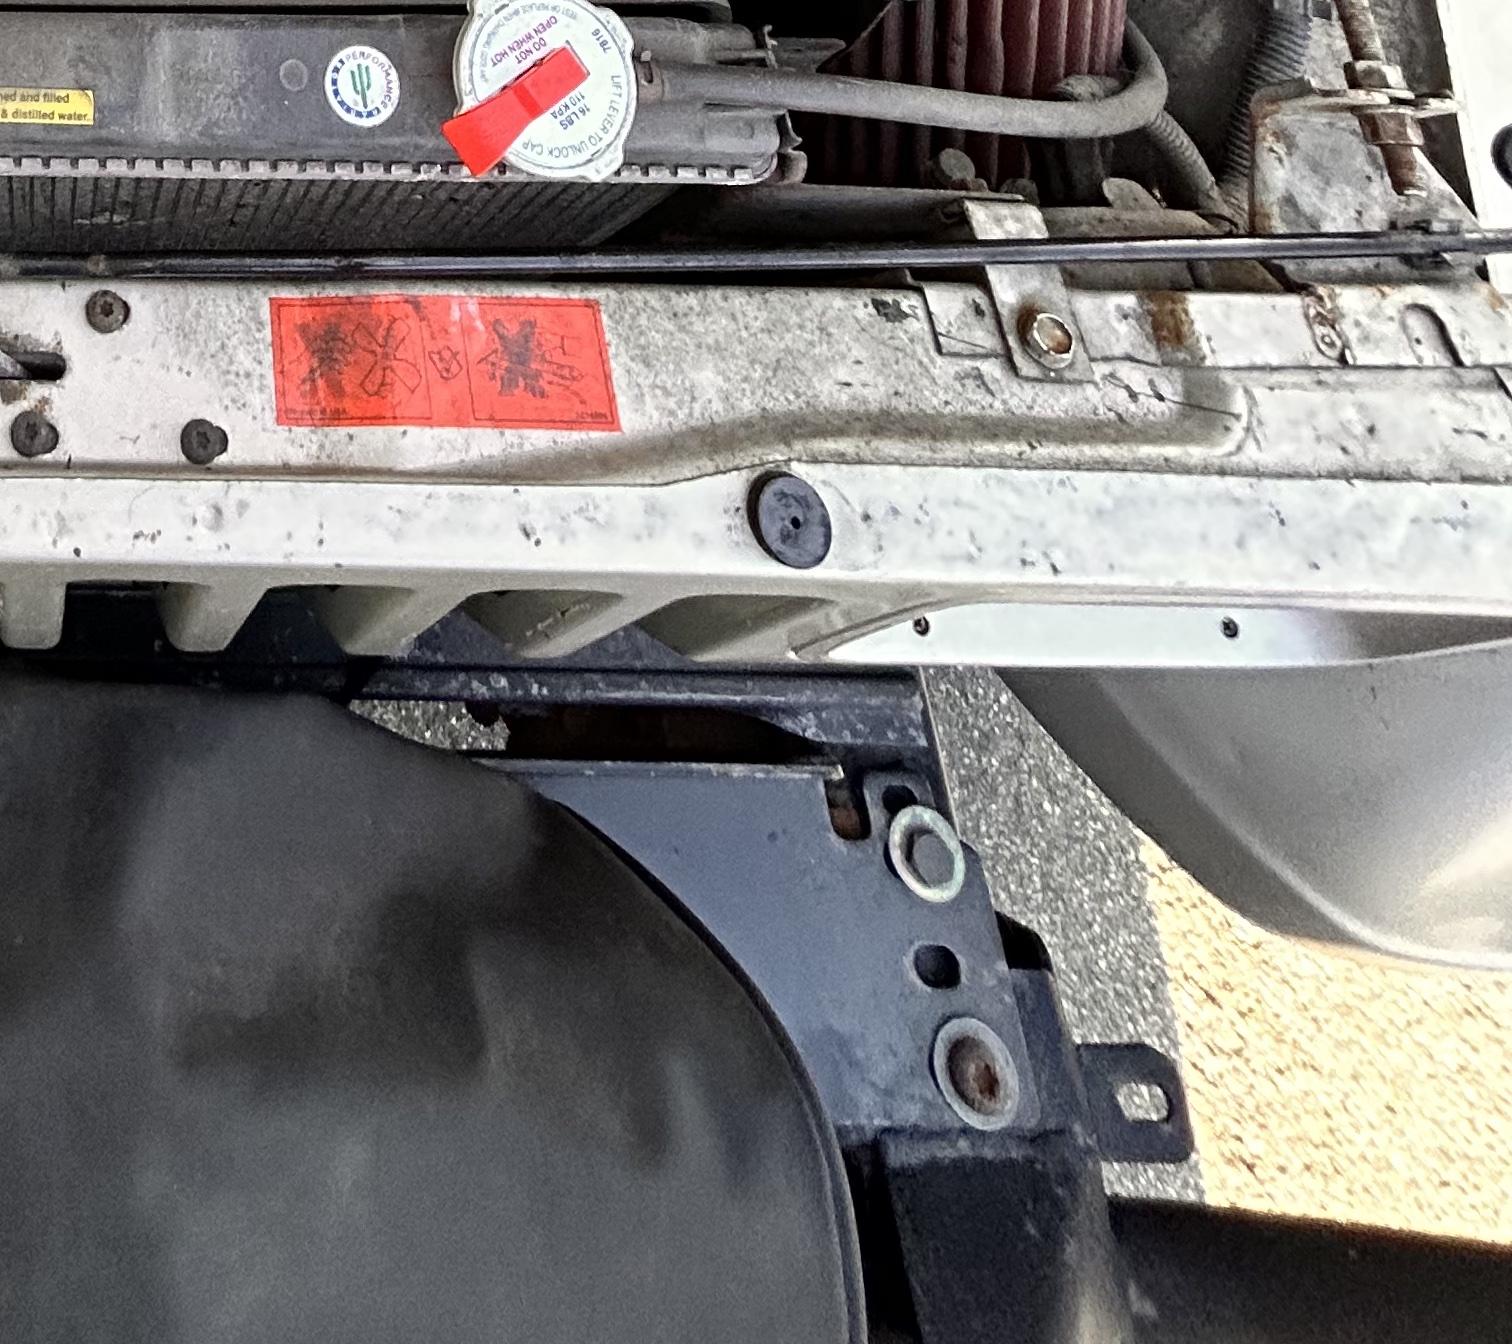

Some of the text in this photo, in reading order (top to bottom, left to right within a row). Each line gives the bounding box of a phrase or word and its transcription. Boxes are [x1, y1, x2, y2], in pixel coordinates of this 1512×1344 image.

[490, 15, 558, 67] OPEN WHEN HOT
[515, 37, 547, 64] DO NOT
[591, 28, 612, 53] 7816
[345, 50, 393, 109] PERFORMANCE
[20, 92, 39, 102] and
[43, 92, 70, 103] filled
[550, 91, 585, 119] 110 KPA
[12, 109, 55, 120] distilled
[521, 75, 622, 158] LIFT LEVER TO UNLOCK CAP
[560, 103, 591, 130] 16 LBS
